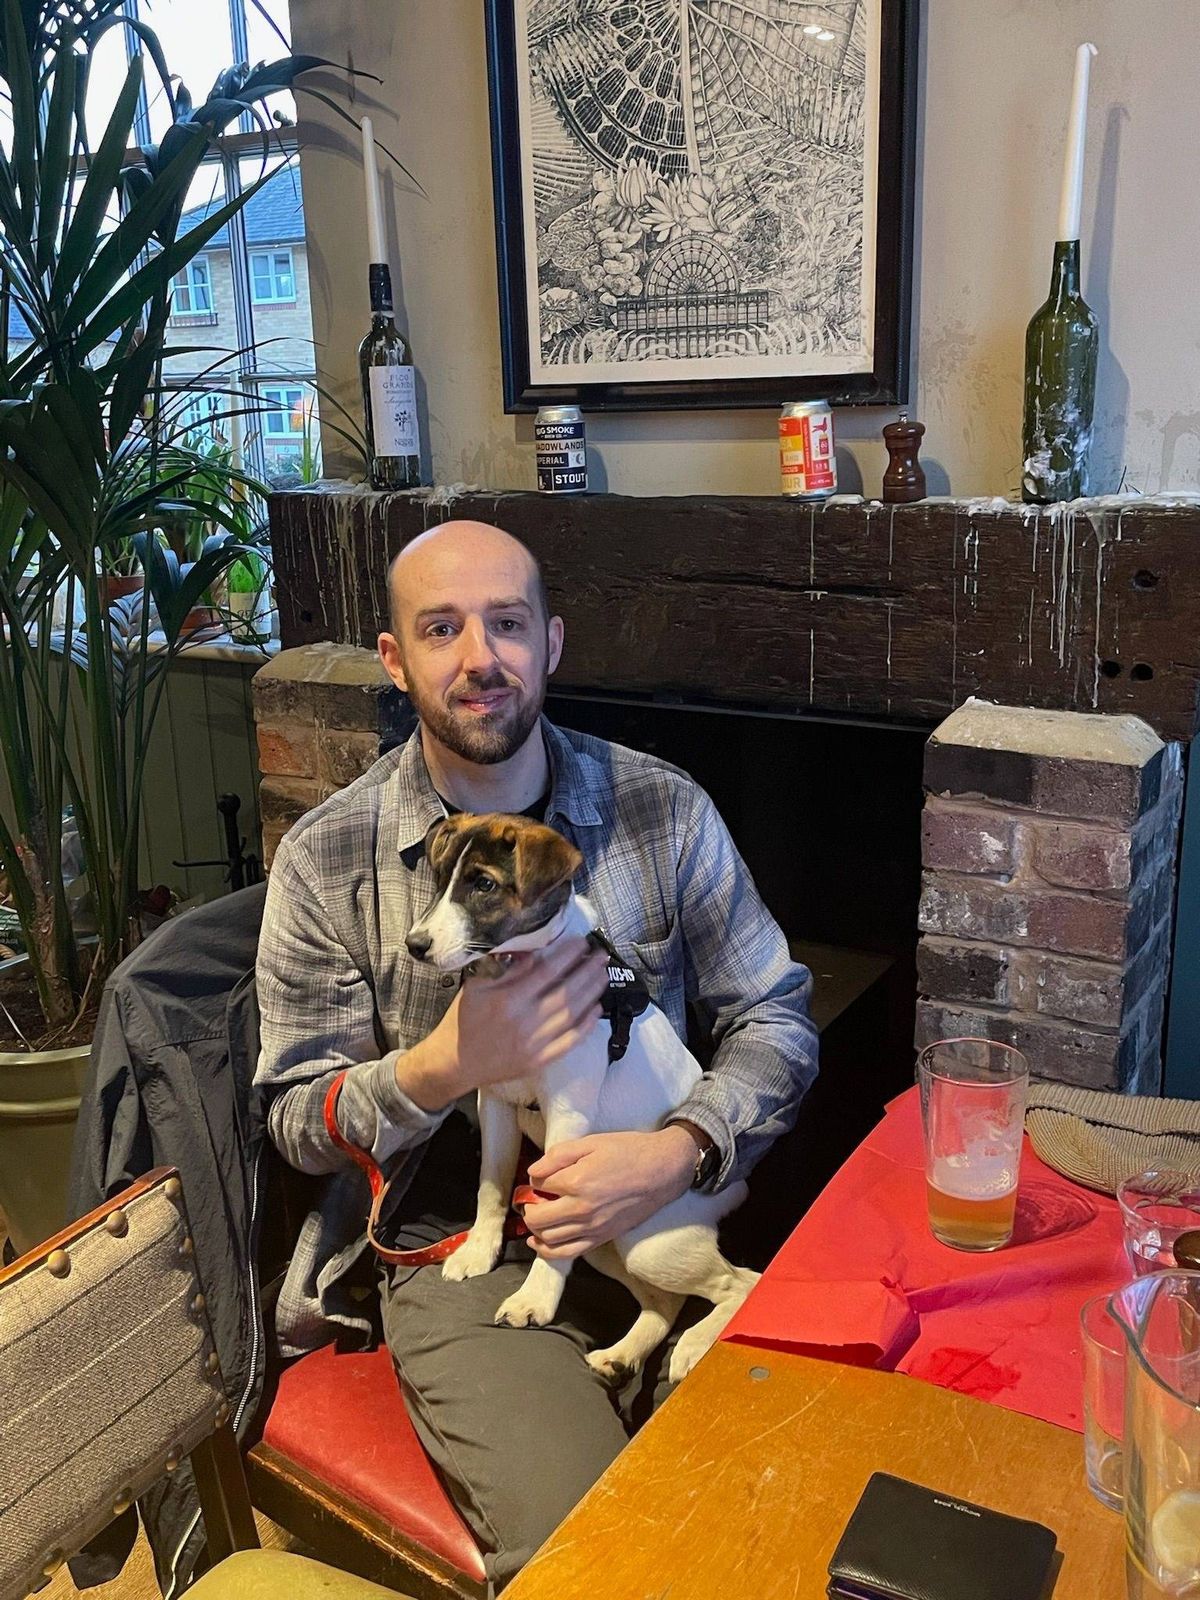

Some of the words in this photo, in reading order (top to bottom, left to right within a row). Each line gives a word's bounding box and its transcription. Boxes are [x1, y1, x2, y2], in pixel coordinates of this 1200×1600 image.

[547, 426, 575, 435] SMOKE
[536, 441, 584, 451] ADOWLANDS
[537, 456, 565, 465] PERIAL
[555, 473, 585, 484] STOUT
[607, 966, 635, 981] IUS-K9
